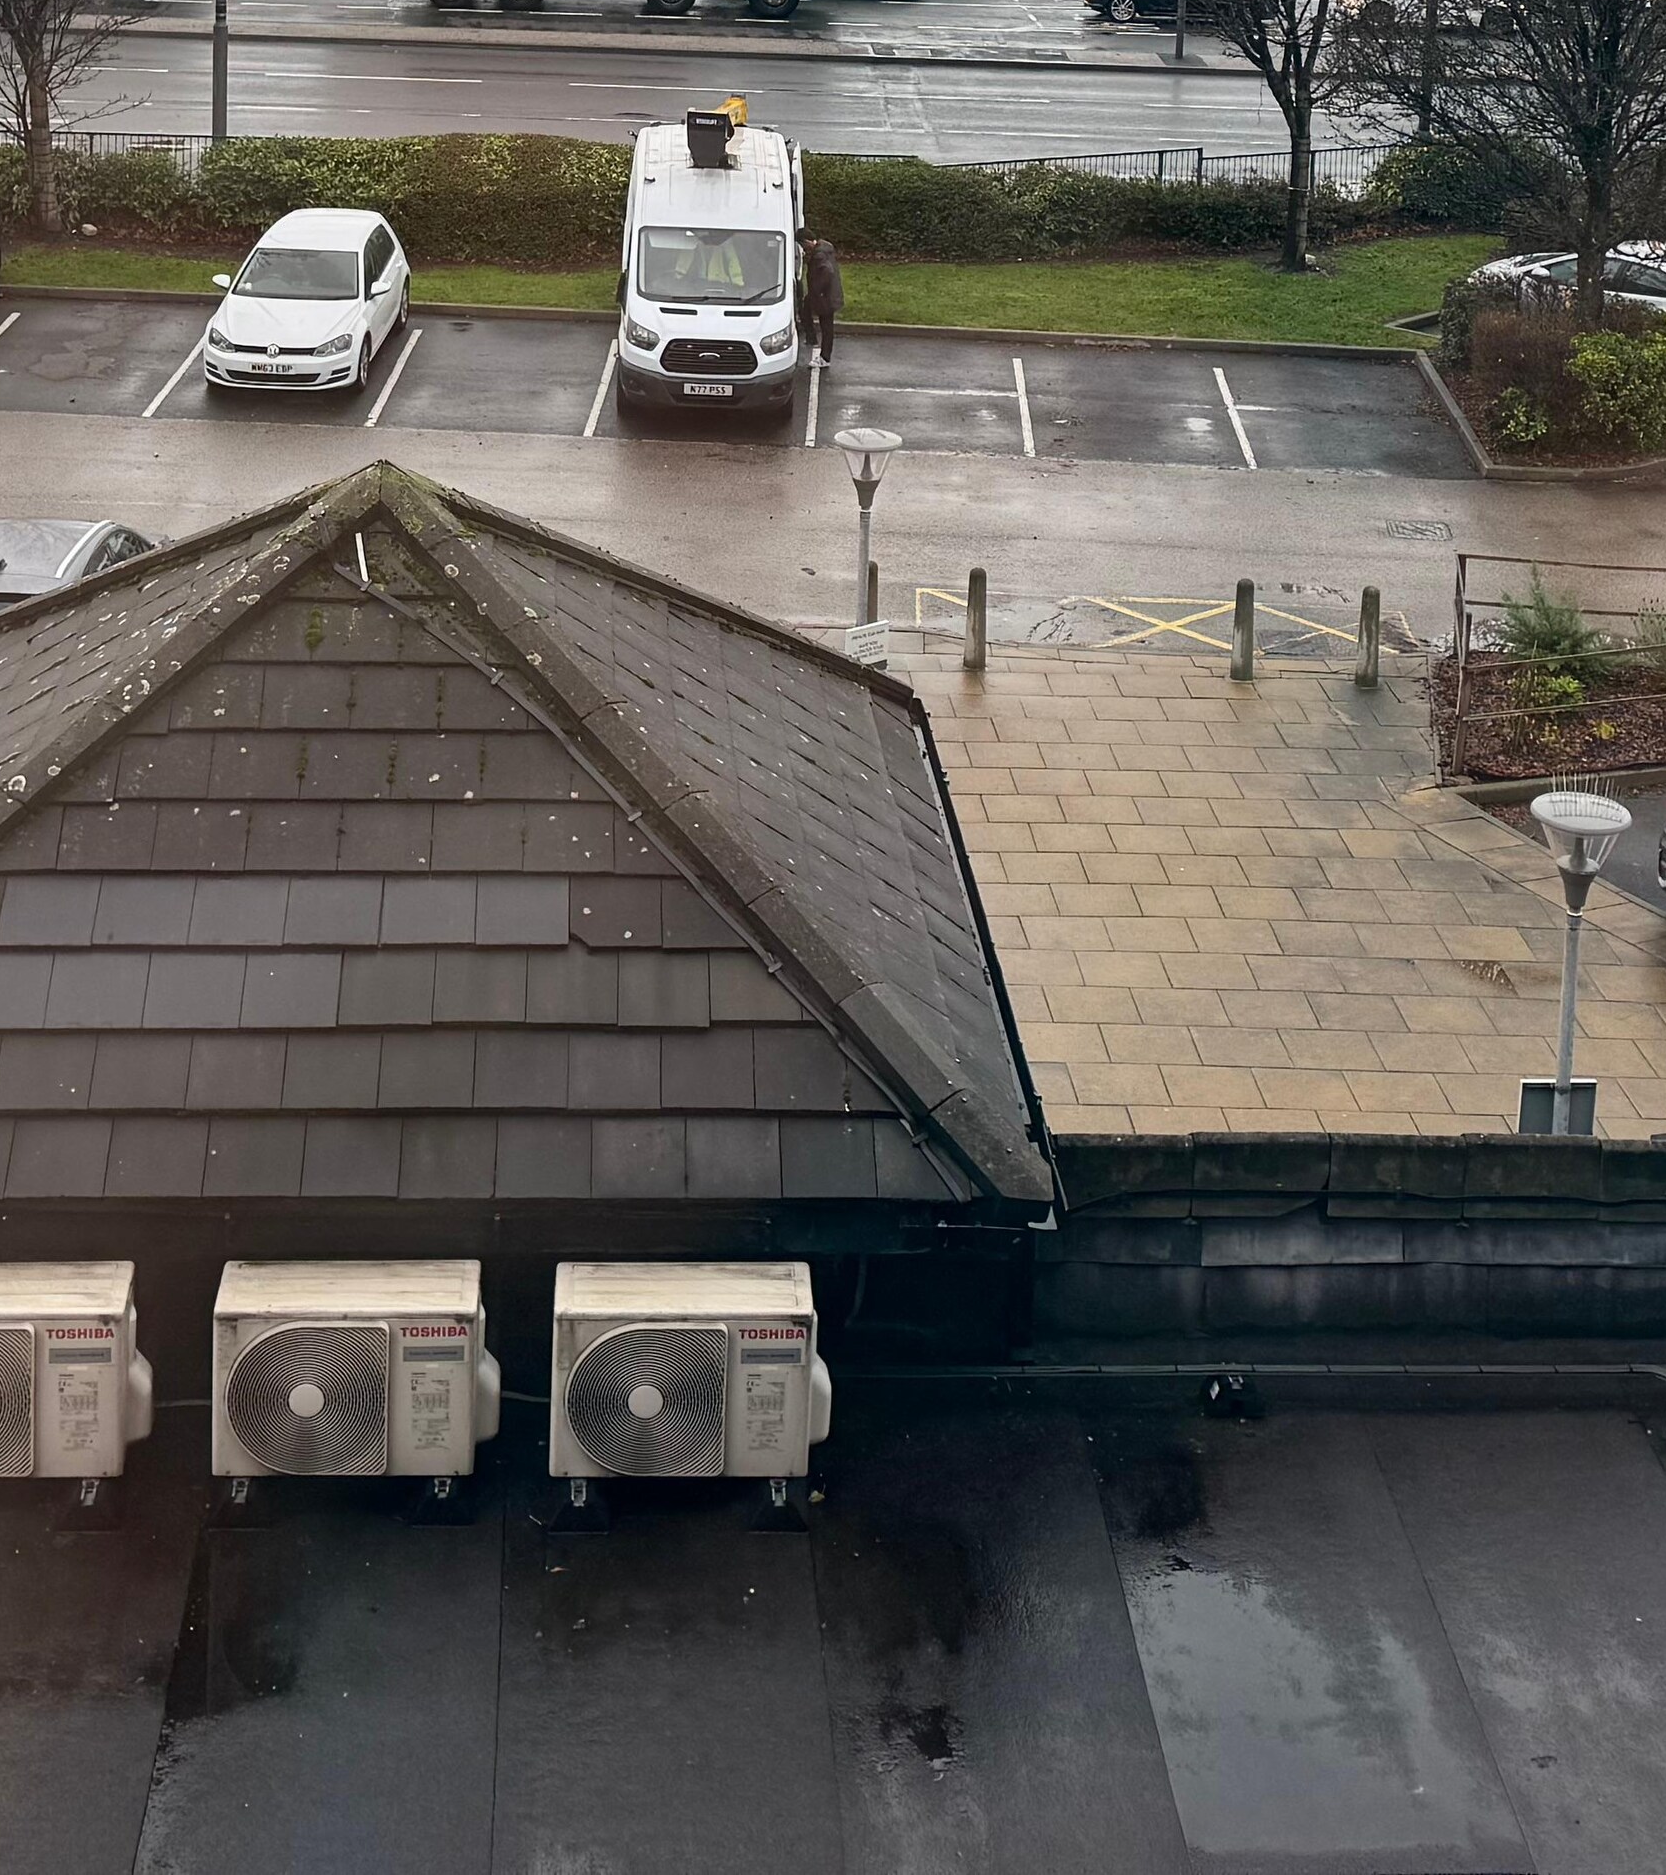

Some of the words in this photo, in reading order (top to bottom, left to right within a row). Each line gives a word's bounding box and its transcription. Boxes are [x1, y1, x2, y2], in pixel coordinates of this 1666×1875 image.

[46, 1328, 114, 1339] TOSHIBA
[400, 1326, 468, 1338] TOSHIBA
[738, 1329, 805, 1340] TOSHIBA
